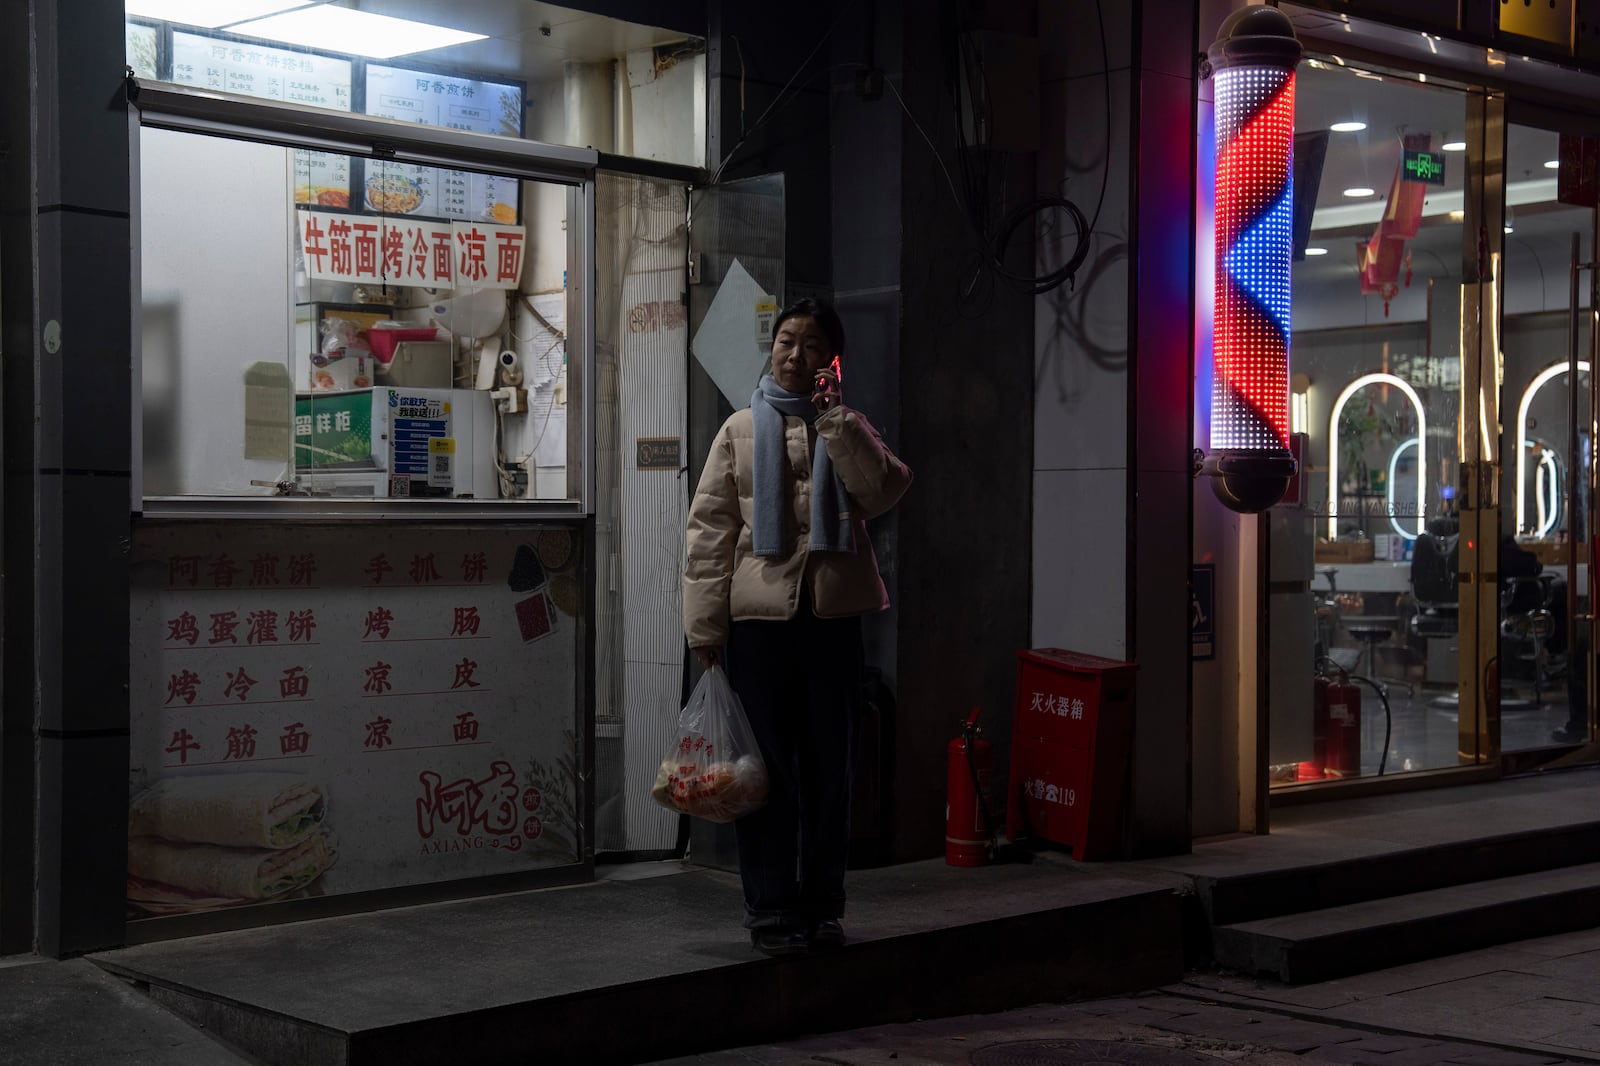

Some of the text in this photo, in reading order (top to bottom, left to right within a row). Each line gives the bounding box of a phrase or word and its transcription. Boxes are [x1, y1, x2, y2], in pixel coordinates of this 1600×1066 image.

[415, 78, 475, 98] 阿香煎饼
[295, 410, 351, 436] 留样柜
[168, 553, 318, 587] 阿香煎饼
[364, 552, 488, 583] 手抓饼
[166, 606, 317, 646] 鸡蛋灌饼
[165, 666, 309, 706] 烤冷面
[1029, 691, 1085, 721] 灭火器箱
[165, 722, 310, 764] 牛筋面
[420, 836, 484, 856] AXIANG
